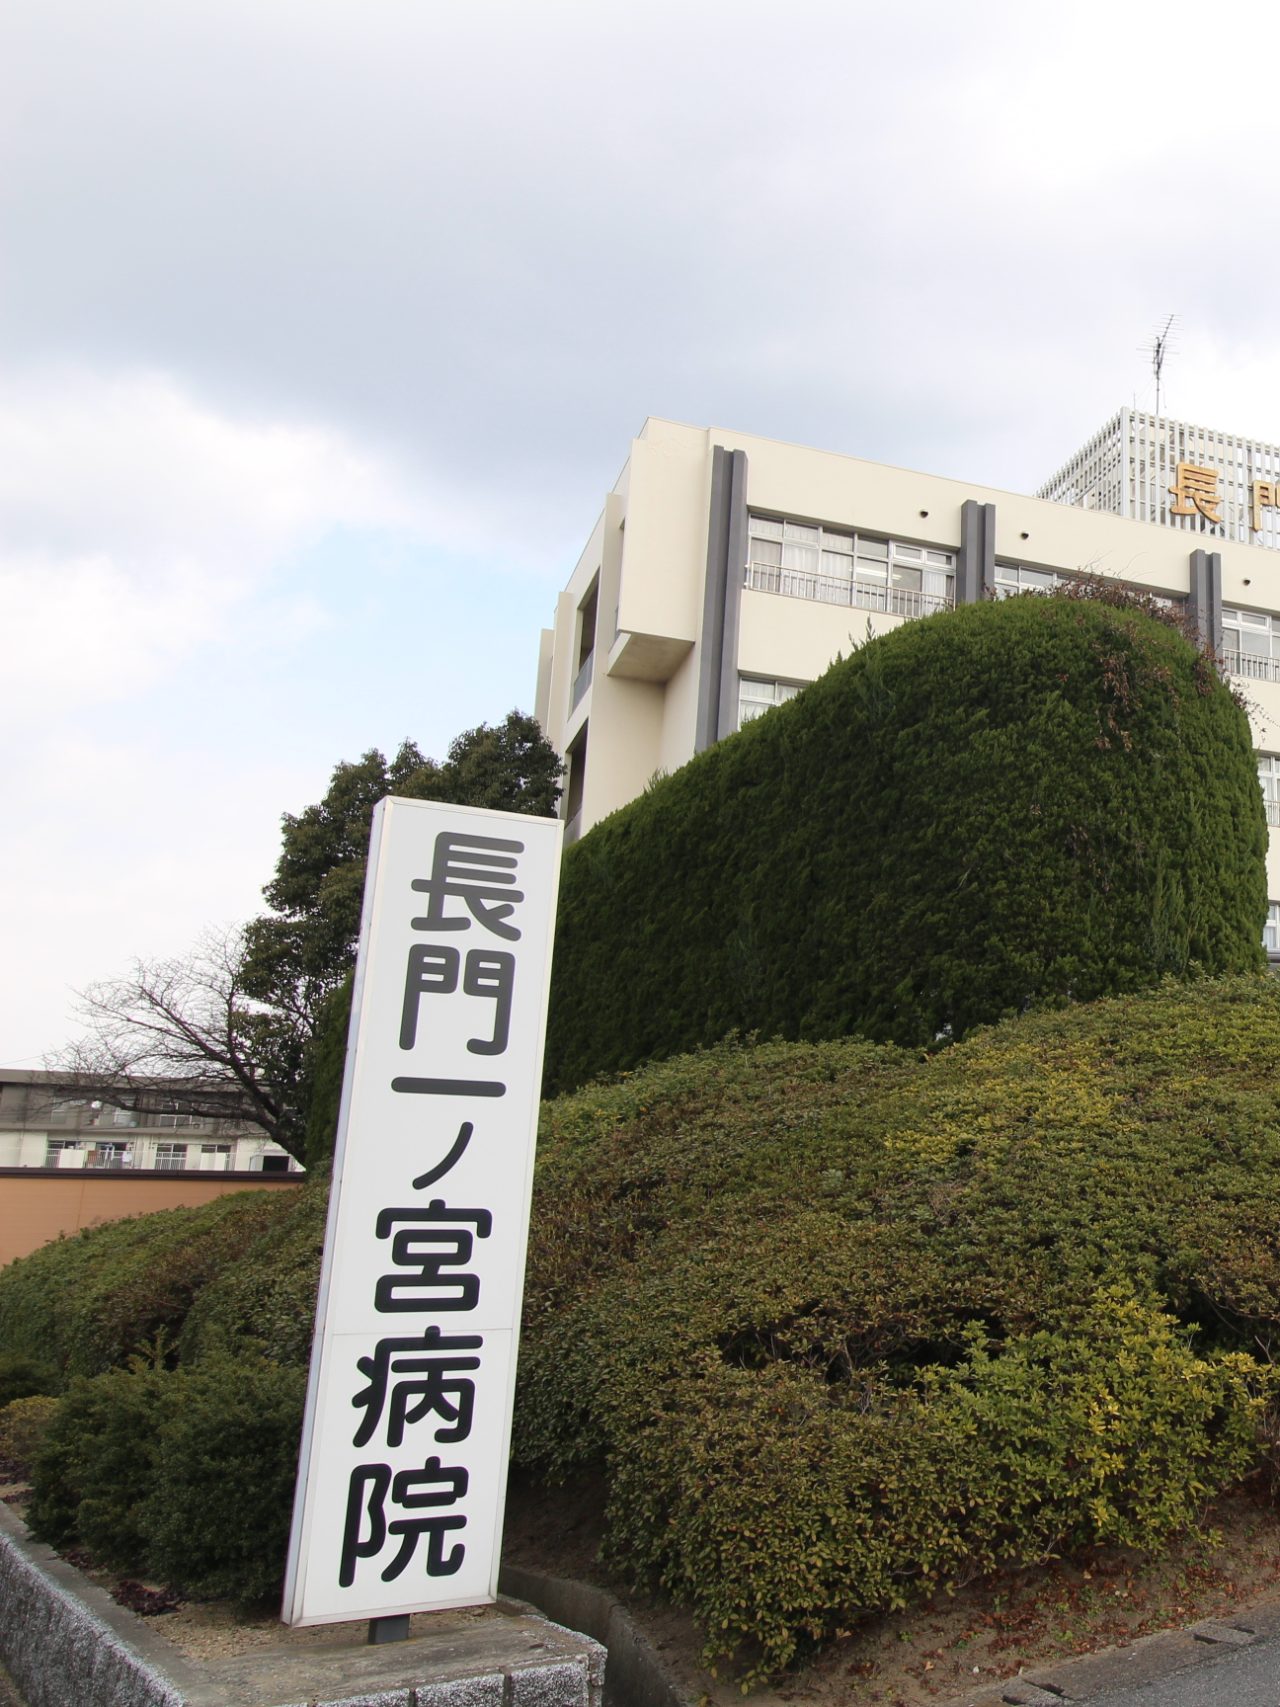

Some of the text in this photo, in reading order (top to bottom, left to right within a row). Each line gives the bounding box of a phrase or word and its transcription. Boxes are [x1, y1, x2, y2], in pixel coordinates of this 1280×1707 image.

[339, 831, 525, 1588] 長門一ノ宮病院
